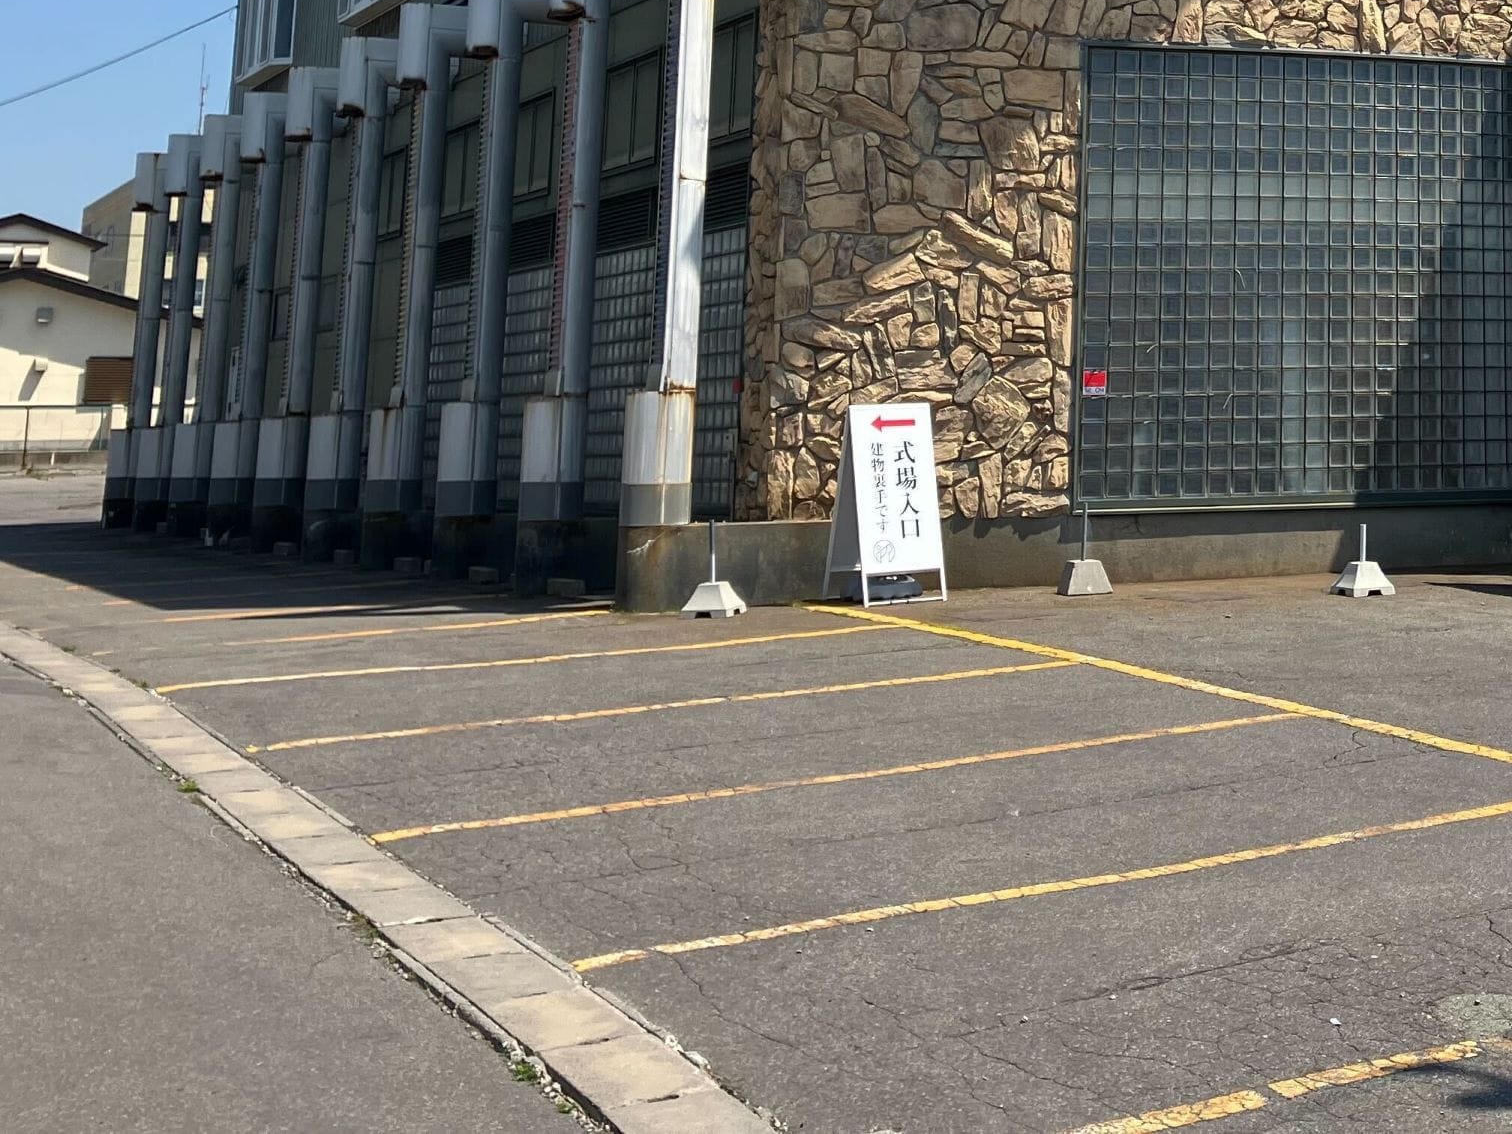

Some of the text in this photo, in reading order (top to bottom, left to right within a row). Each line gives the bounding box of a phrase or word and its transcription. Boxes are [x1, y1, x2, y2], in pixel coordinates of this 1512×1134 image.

[870, 442, 890, 533] 建物裏手です
[894, 440, 920, 539] 式場入口
